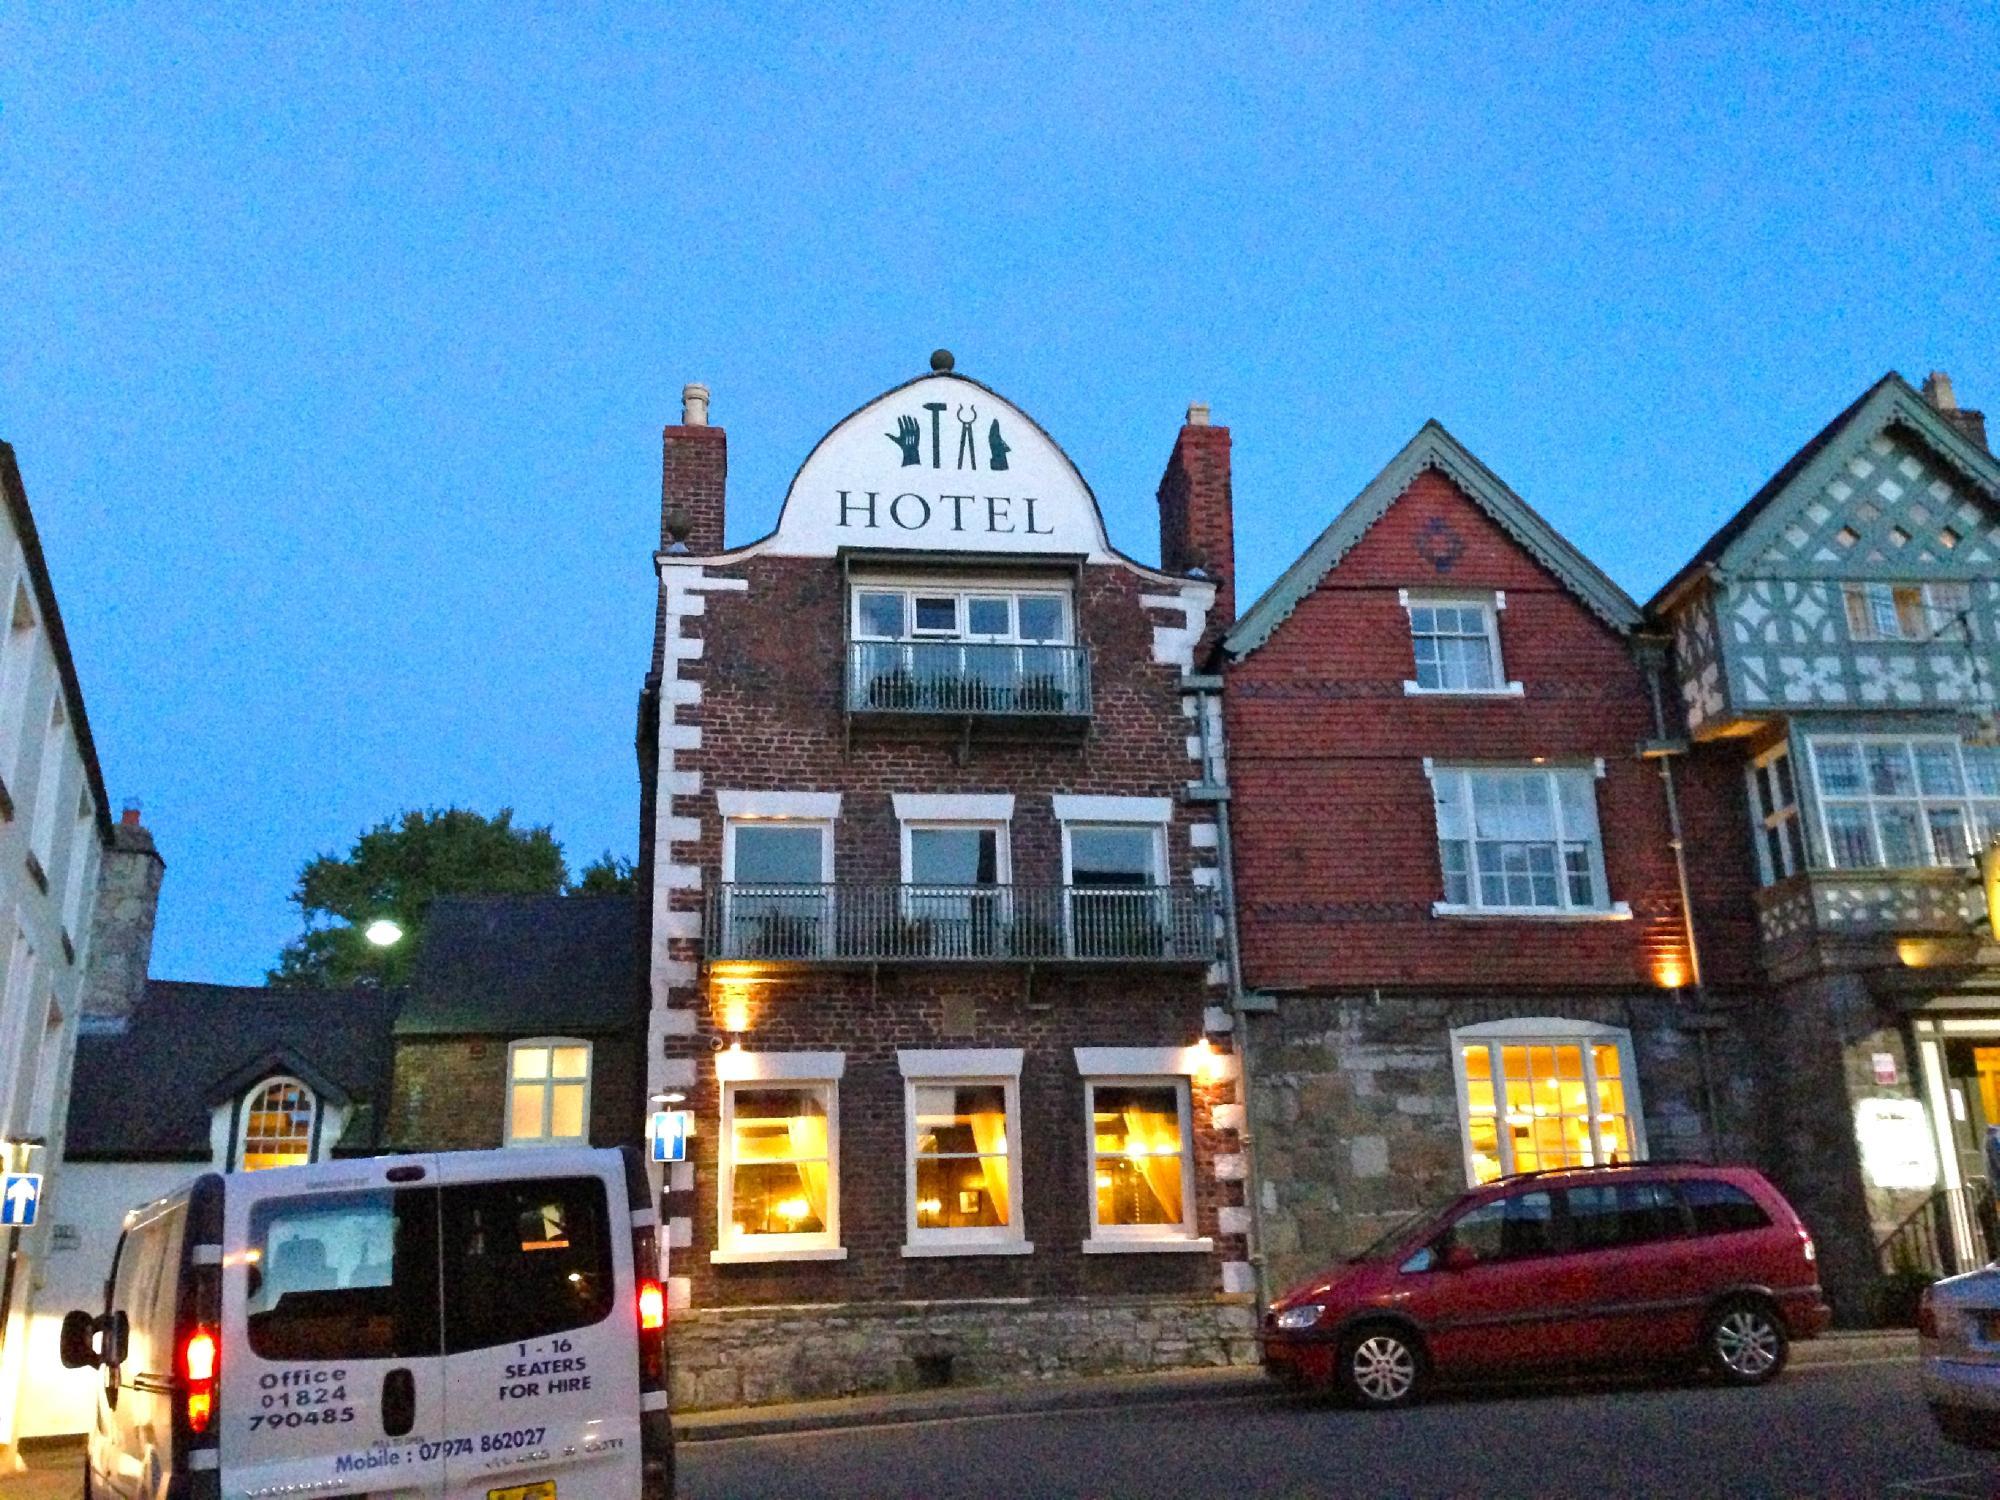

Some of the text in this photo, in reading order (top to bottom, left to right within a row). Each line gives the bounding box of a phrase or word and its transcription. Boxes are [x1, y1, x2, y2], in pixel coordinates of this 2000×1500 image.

[835, 490, 1054, 534] HOTEL
[518, 1343, 527, 1358] 1
[552, 1338, 572, 1354] 16
[259, 1368, 347, 1390] Office
[505, 1356, 587, 1380] SEATERS
[261, 1385, 347, 1409] 01824
[499, 1375, 592, 1400] FOR HIRE
[249, 1406, 355, 1432] 790485
[336, 1447, 400, 1473] Mobile
[418, 1437, 474, 1462] 07974
[481, 1428, 546, 1453] 862027
